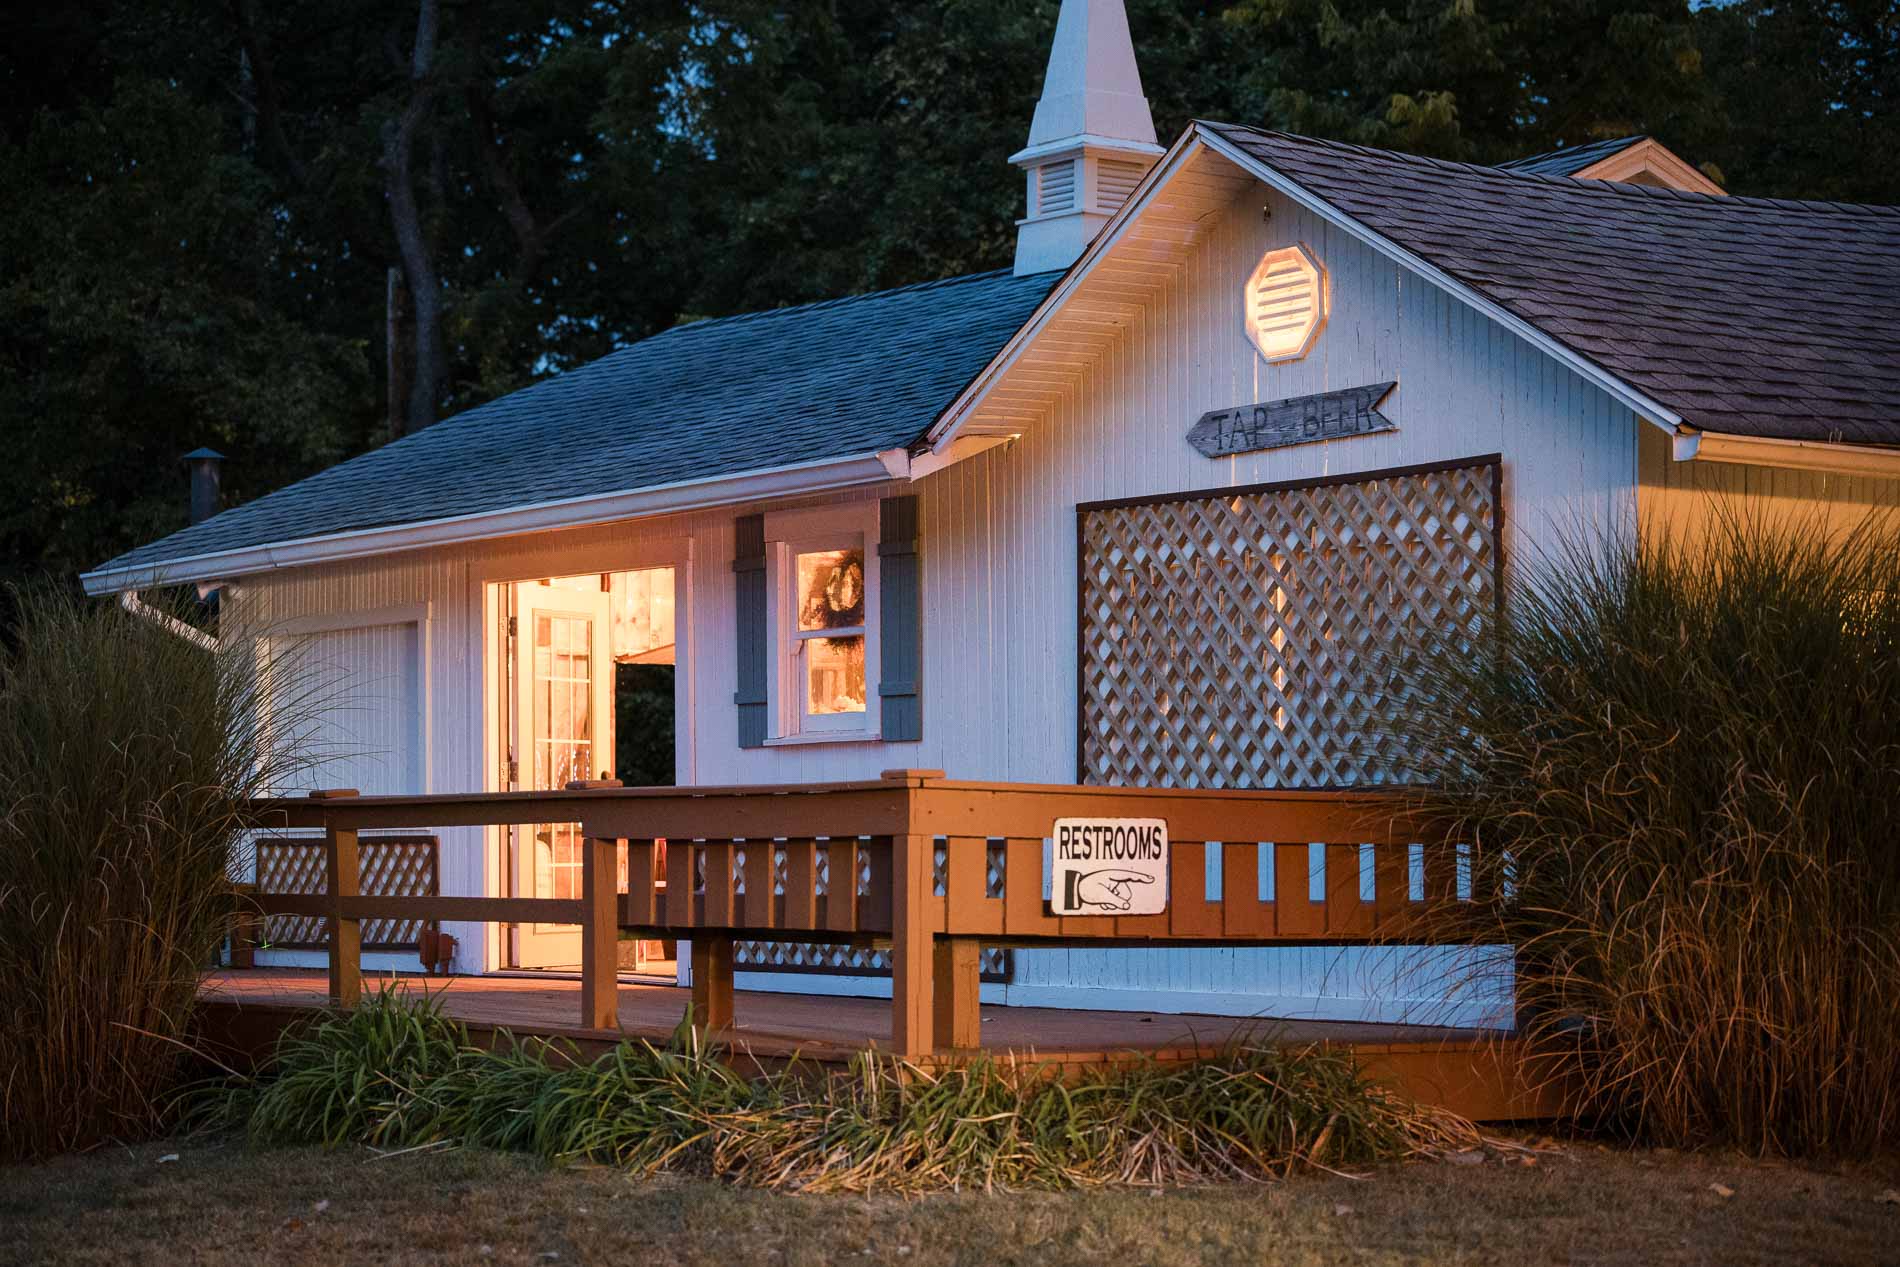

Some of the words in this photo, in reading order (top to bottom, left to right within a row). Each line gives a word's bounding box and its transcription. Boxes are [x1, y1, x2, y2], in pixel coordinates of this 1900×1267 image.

[1211, 407, 1268, 450] TAP
[1302, 391, 1375, 437] BEER
[1059, 826, 1162, 860] RESTROOMS
